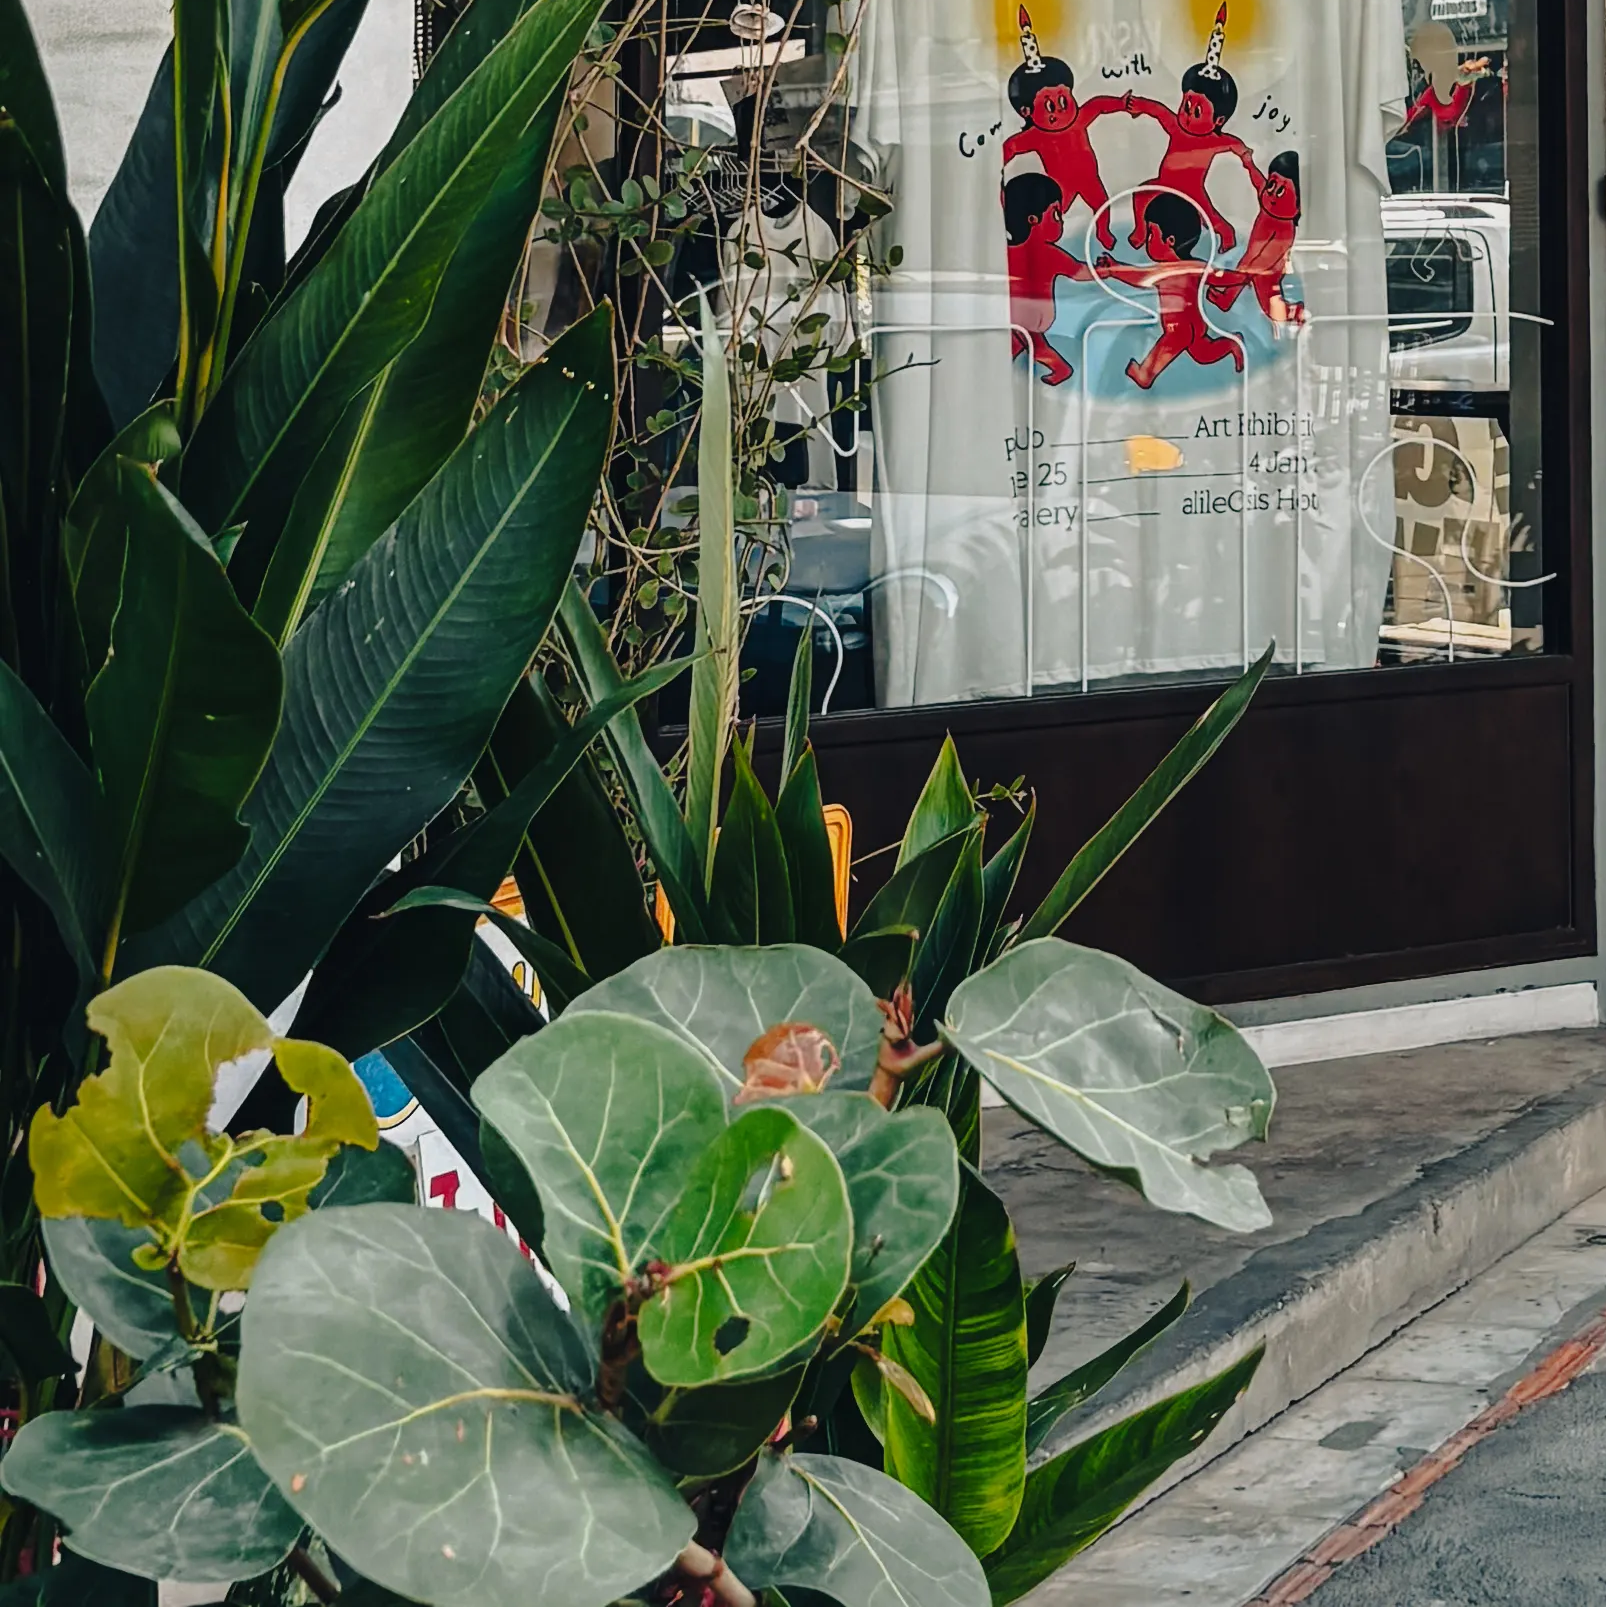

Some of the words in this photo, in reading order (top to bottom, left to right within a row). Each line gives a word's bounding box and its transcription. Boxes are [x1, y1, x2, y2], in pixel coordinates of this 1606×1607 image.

[1102, 52, 1152, 79] with
[1194, 415, 1232, 438] Art
[1037, 461, 1067, 487] 25
